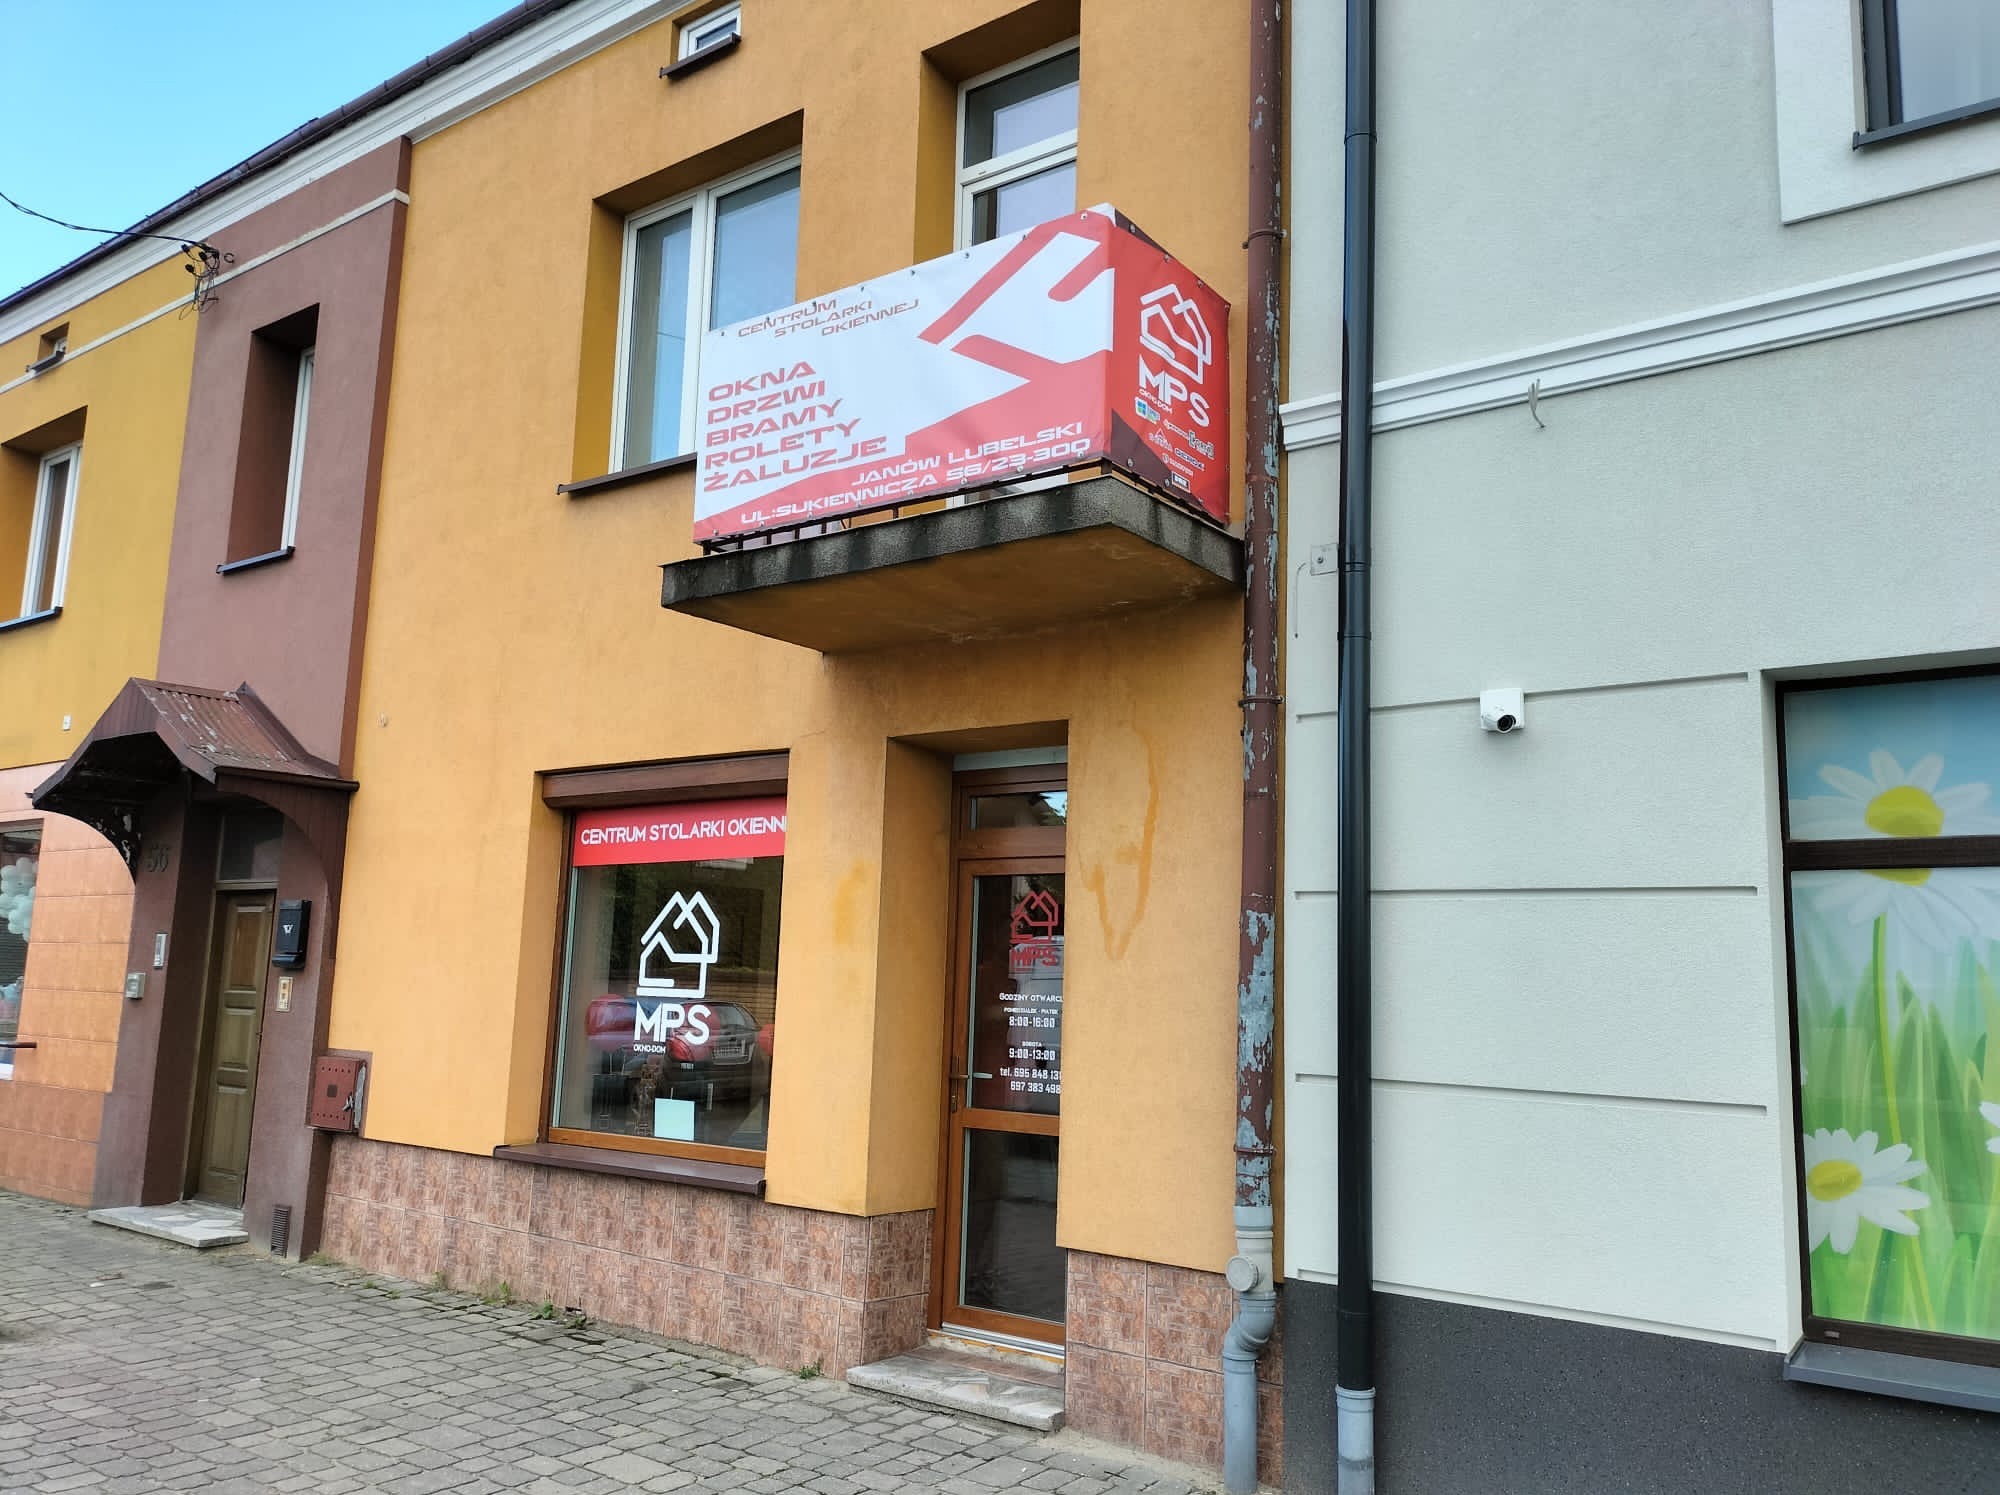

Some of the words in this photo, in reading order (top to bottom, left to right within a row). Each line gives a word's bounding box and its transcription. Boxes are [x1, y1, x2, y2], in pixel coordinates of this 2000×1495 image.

[738, 299, 837, 337] CENTRUM
[774, 301, 873, 338] STOLARKI
[821, 299, 920, 336] OKIENNEJ
[708, 361, 817, 402] OKNA
[1138, 354, 1210, 428] MPS
[707, 380, 826, 425] DRZWI
[706, 398, 844, 448] BRAMY
[704, 417, 863, 470] ROLETY
[851, 455, 941, 487] JANÓW
[947, 421, 1083, 465] LUBELSKI
[703, 435, 888, 493] ŻALUZJE
[581, 826, 646, 845] CENTRUM
[649, 818, 725, 842] STOLARKI
[1010, 945, 1058, 967] MPS
[633, 1000, 712, 1046] MPS
[1009, 1016, 1056, 1028] 8:00-16:00
[1000, 1067, 1013, 1077] tel.
[1014, 1067, 1030, 1078] 695
[1032, 1069, 1048, 1079] 848
[1009, 1047, 1056, 1061] 9:00-13:00
[1010, 1081, 1026, 1091] 697
[1027, 1082, 1043, 1092] 383
[1045, 1083, 1062, 1094] 498
